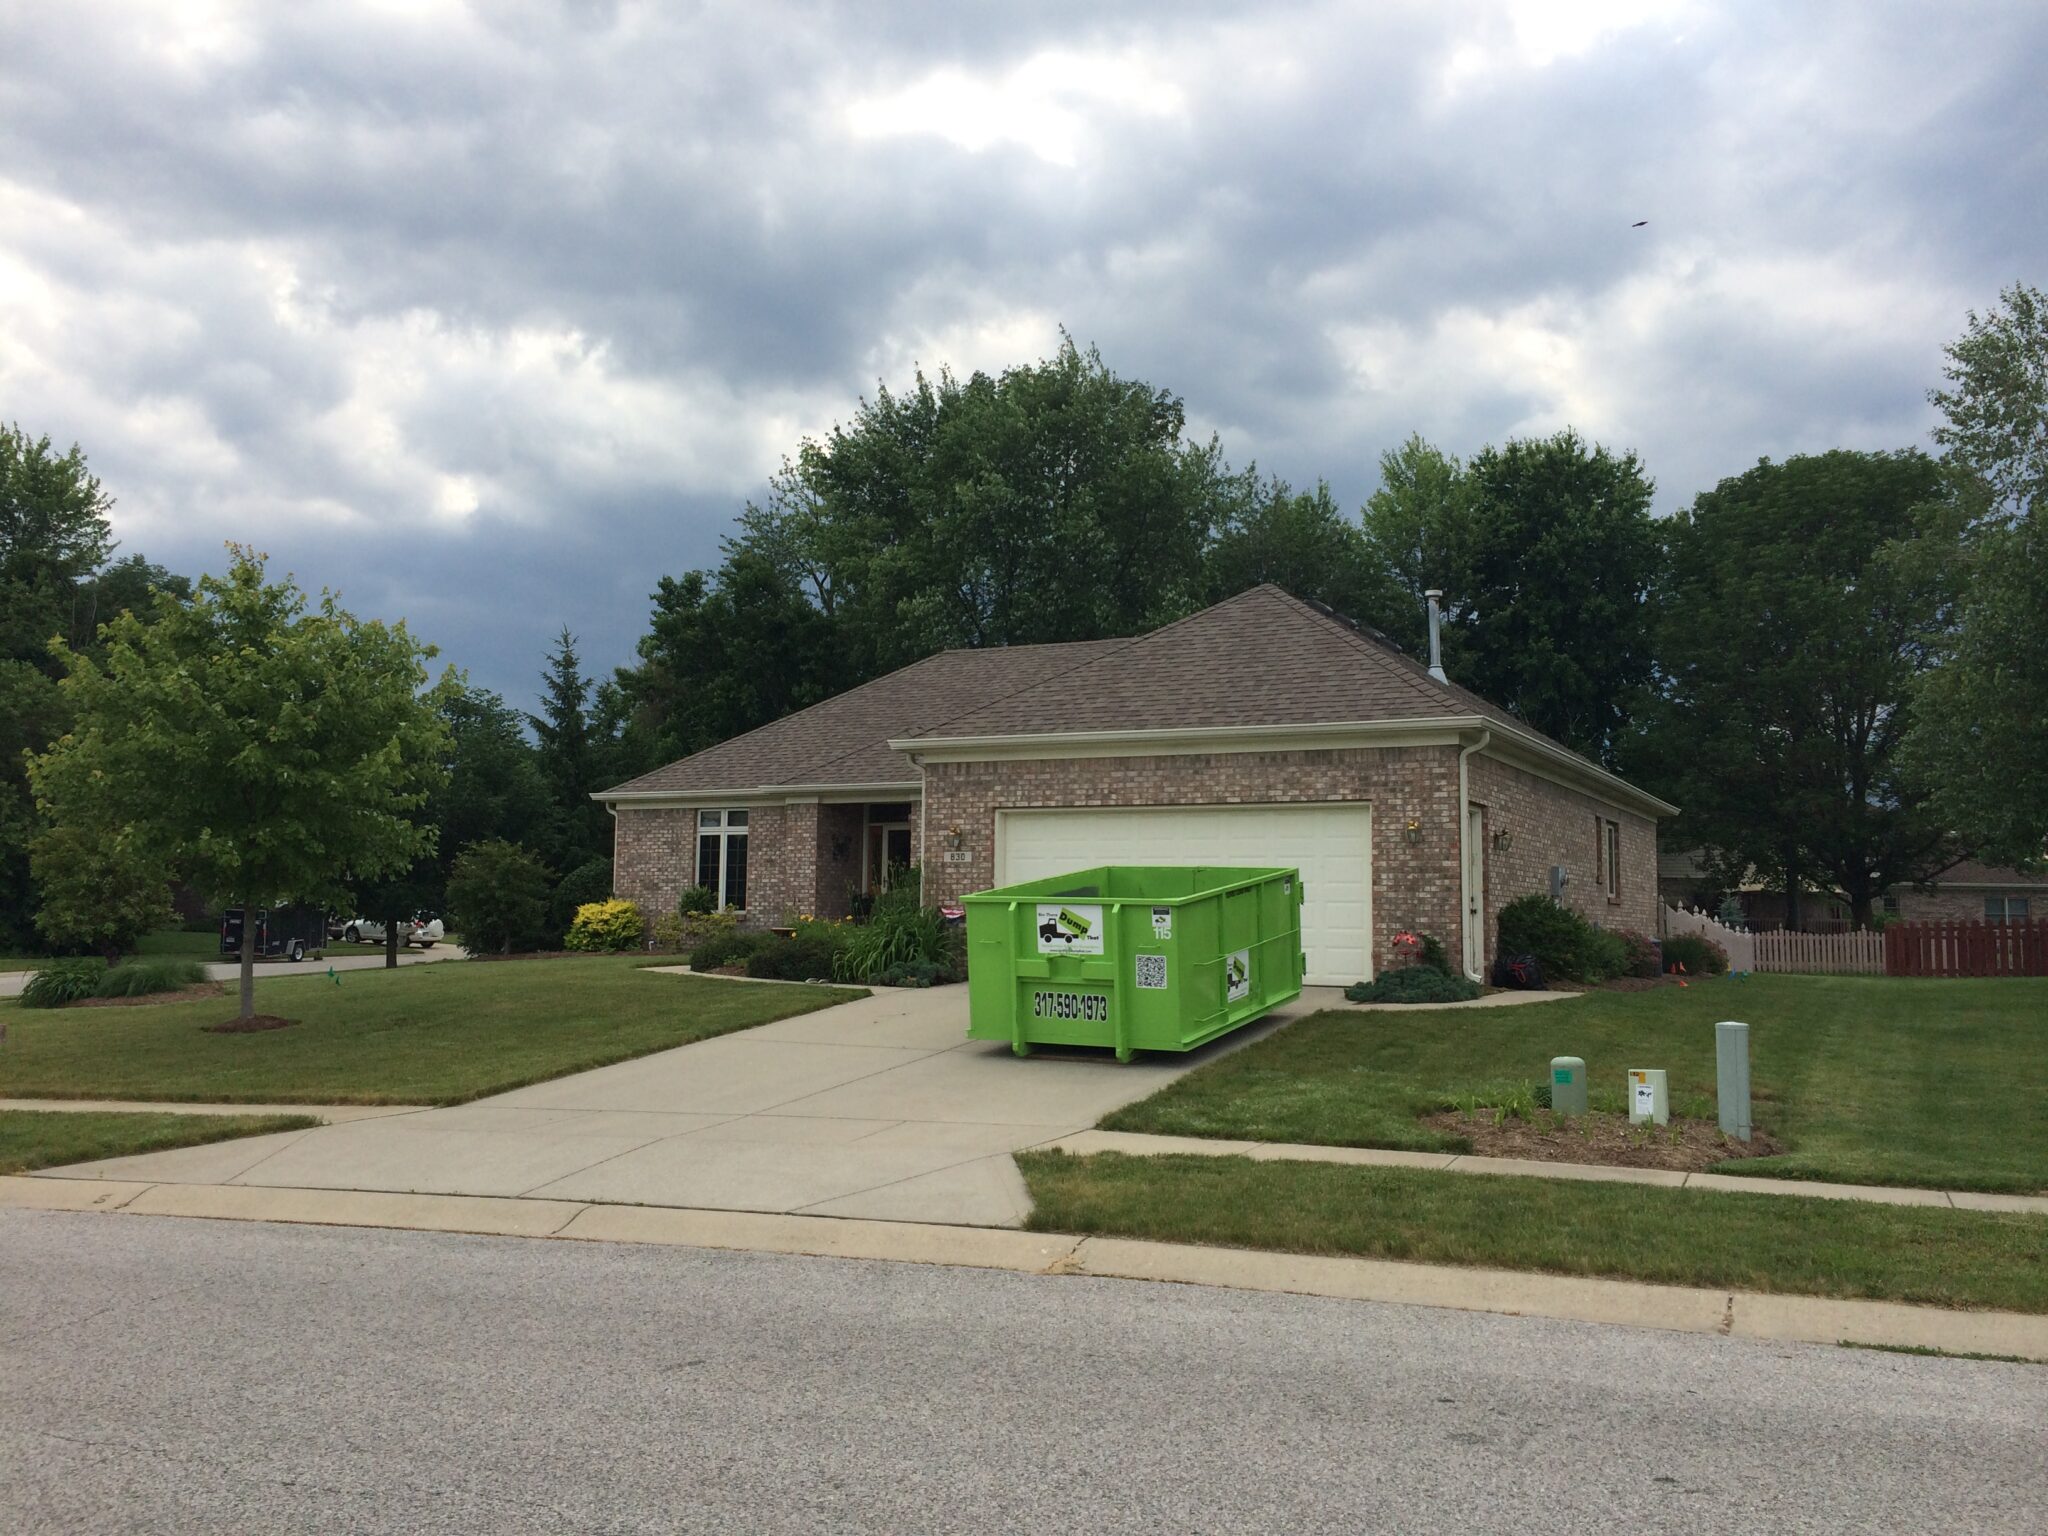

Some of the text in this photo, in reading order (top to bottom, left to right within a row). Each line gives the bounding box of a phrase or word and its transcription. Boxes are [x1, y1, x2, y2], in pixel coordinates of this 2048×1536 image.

[950, 852, 966, 861] 830
[1058, 911, 1089, 935] Dump
[1153, 926, 1172, 940] 115
[1034, 991, 1107, 1022] 317-590-1973
